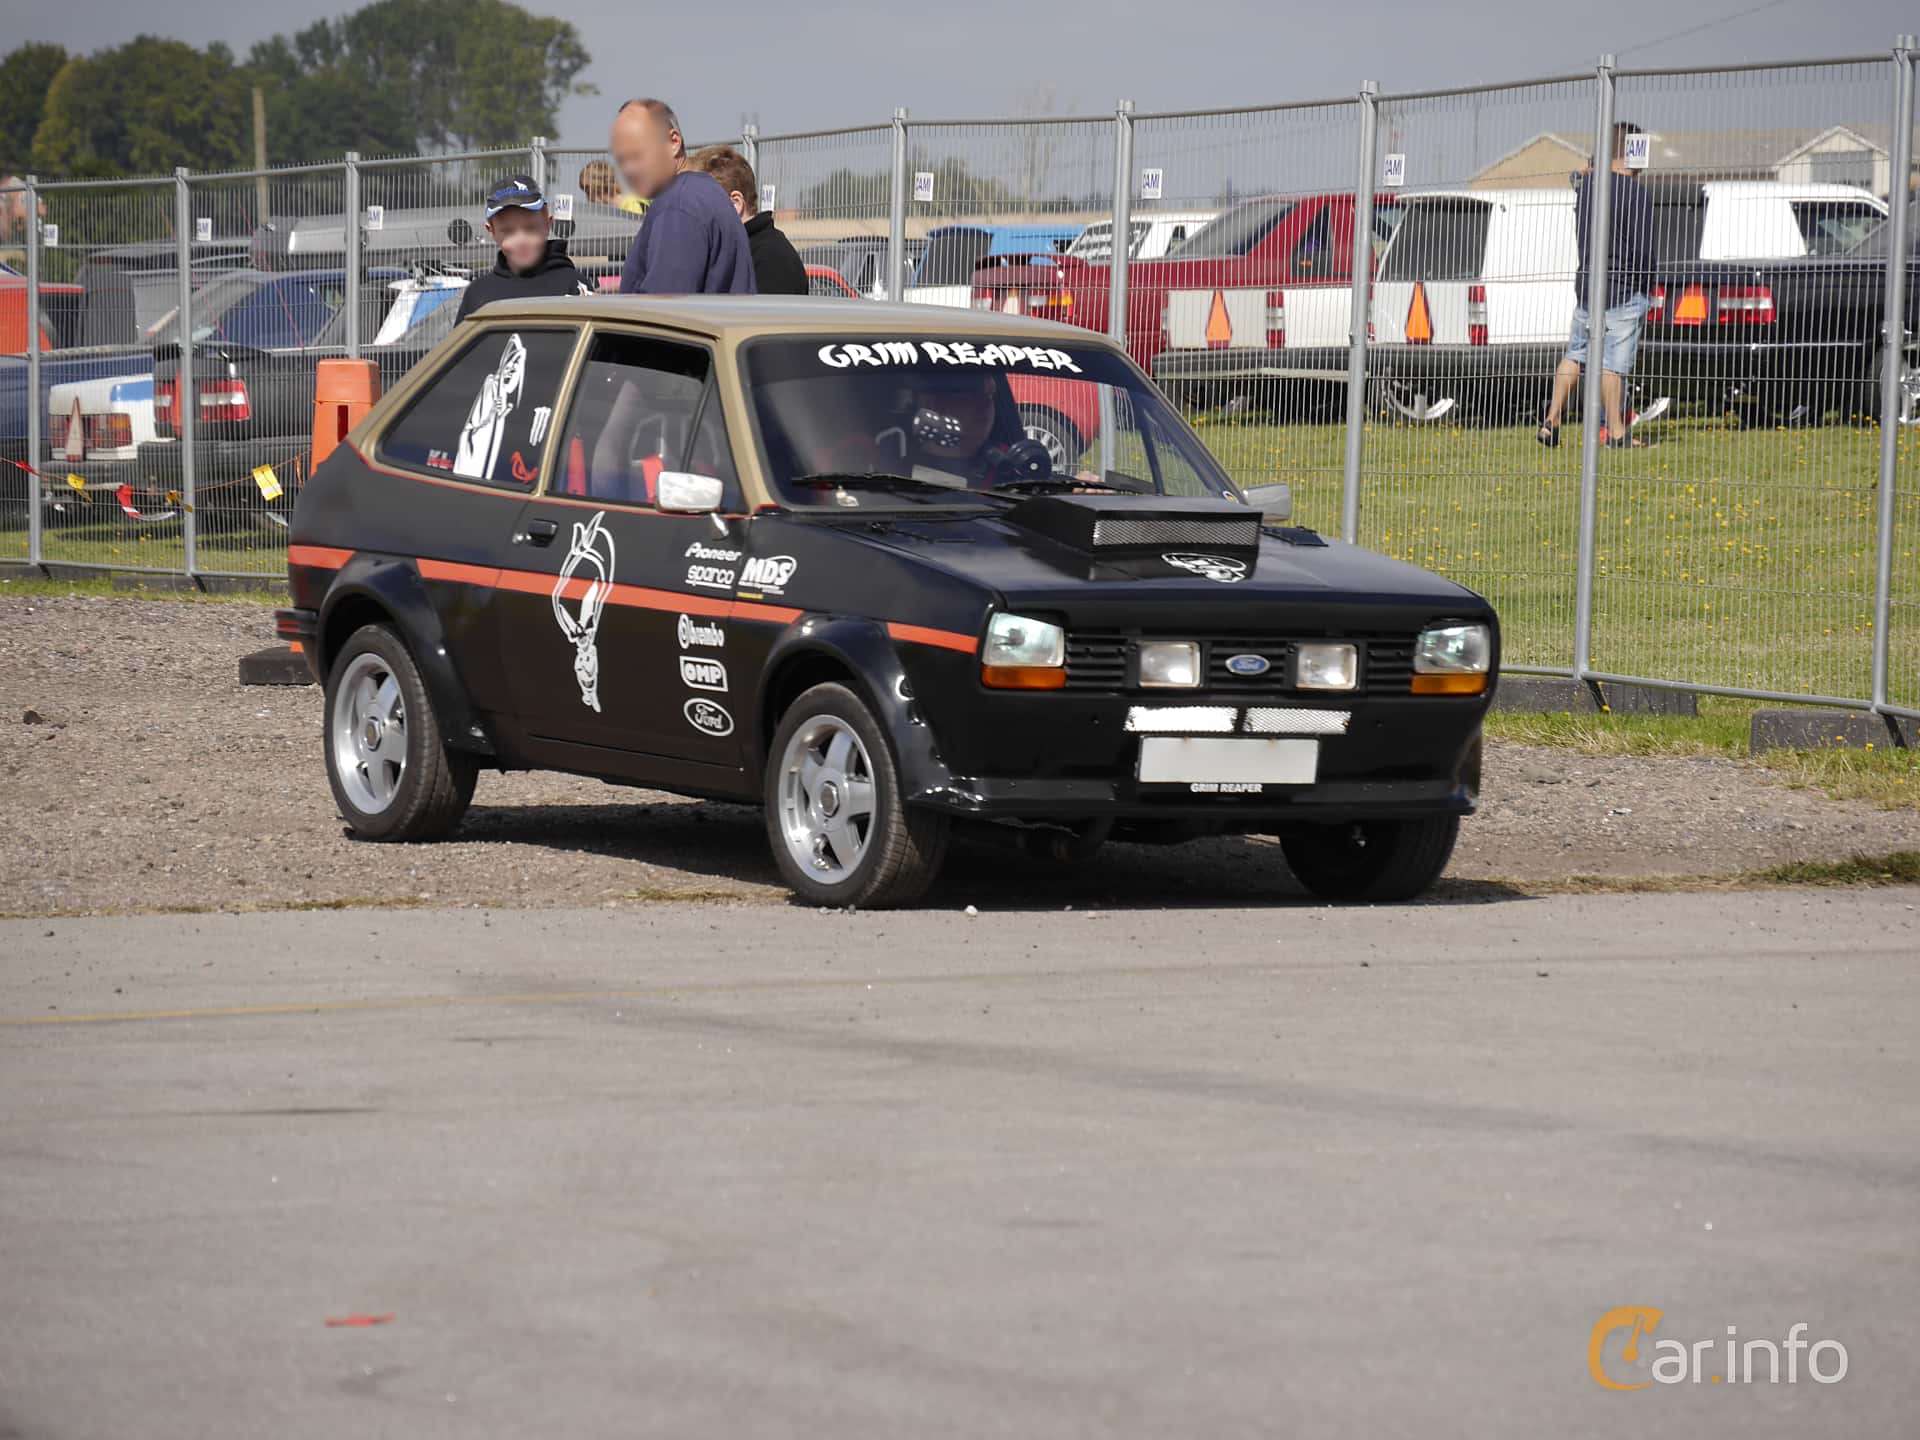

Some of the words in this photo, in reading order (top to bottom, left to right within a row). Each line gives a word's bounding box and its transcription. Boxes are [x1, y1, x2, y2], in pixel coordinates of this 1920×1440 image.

[818, 342, 918, 368] GRIM
[920, 341, 1083, 373] REAPER
[685, 542, 742, 561] Pioneer
[687, 564, 735, 586] sparco
[740, 556, 793, 586] MDS
[684, 662, 722, 684] OMP
[695, 703, 723, 729] Ford
[1190, 783, 1219, 793] GRIM
[1220, 783, 1263, 793] REAPER
